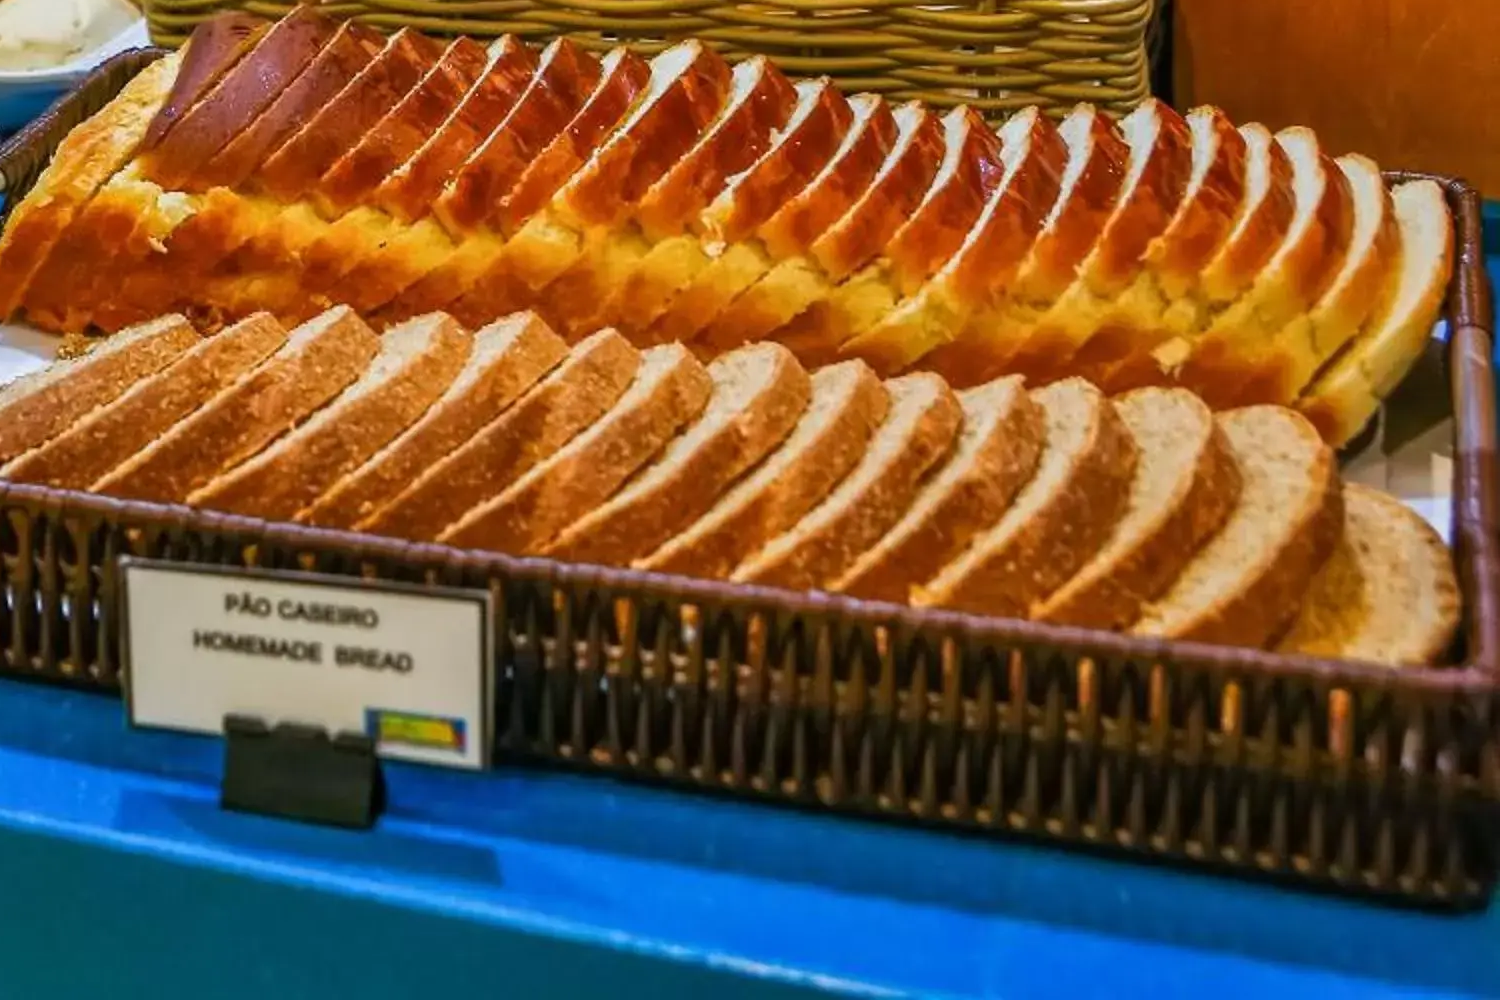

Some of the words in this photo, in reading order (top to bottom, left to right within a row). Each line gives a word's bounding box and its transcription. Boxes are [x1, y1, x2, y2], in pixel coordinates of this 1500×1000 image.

[223, 592, 271, 619] PÃO
[277, 600, 380, 630] CASEIRO
[192, 629, 323, 665] HOMEMADE
[334, 644, 414, 673] BREAD
